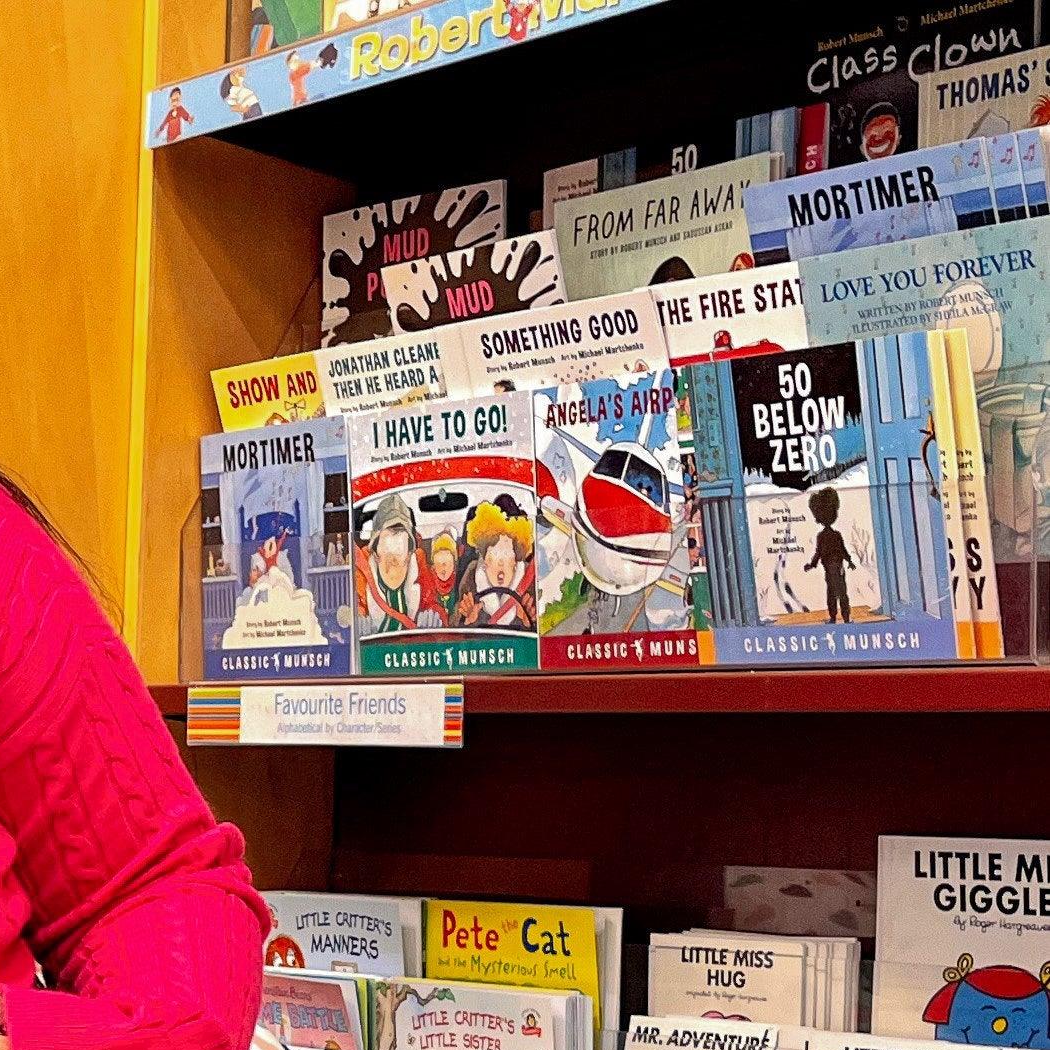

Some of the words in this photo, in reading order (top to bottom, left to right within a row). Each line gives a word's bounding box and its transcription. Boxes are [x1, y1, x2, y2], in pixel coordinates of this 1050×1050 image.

[920, 9, 957, 26] Michael
[349, 0, 514, 80] Robert
[817, 37, 846, 52] Robert
[807, 44, 897, 94] Class
[908, 27, 1022, 83] Clown
[936, 60, 1037, 110] THOMAS'
[671, 144, 698, 175] 50
[787, 166, 940, 228] MORTIMER
[574, 207, 633, 246] FROM
[644, 195, 680, 229] FAR
[383, 227, 429, 263] MUD
[620, 241, 643, 253] ROBERT
[645, 235, 668, 248] MUNSCH
[821, 274, 876, 304] LOVE
[879, 266, 926, 292] YOU
[933, 249, 1036, 285] FOREVER
[446, 280, 495, 318] MUD
[656, 298, 693, 326] THE
[699, 288, 745, 320] FIRE
[857, 302, 904, 320] WRITTEN
[906, 301, 918, 312] BY
[919, 294, 957, 310] ROBERT
[480, 317, 583, 360] SOMETHING
[589, 309, 640, 341] GOOD
[508, 359, 530, 371] Robert
[531, 356, 556, 367] Munsch
[578, 348, 604, 360] Michael
[605, 343, 644, 355] Martchenko
[328, 353, 390, 378] JONATHAN
[227, 375, 280, 409] SHOW
[286, 370, 317, 398] AND
[333, 380, 363, 399] THEN
[366, 377, 381, 394] HE
[384, 368, 425, 392] HEARD
[430, 365, 438, 385] A
[778, 362, 812, 399] 50
[359, 402, 379, 412] Robert
[546, 394, 623, 428] ANGELA'S
[631, 387, 674, 417] AIRP
[752, 396, 845, 439] BELOW
[373, 422, 379, 448] I
[386, 415, 434, 447] HAVE
[441, 410, 466, 439] TO
[474, 404, 508, 436] GO!
[222, 432, 316, 473] MORTIMER
[391, 452, 410, 461] Robert
[411, 449, 433, 458] Munsch
[453, 444, 476, 453] Michael
[769, 435, 837, 473] ZERO
[566, 641, 628, 660] CLASSIC
[650, 640, 698, 657] MUNS
[743, 636, 820, 653] CLASSIC
[844, 633, 921, 650] MUNSCH
[222, 656, 270, 670] CLASSIC
[284, 653, 330, 668] MUNSCH
[384, 650, 440, 667] CLASSIC
[458, 648, 515, 664] MUNSCH
[274, 693, 343, 716] Favourite
[349, 693, 406, 715] Friends
[277, 722, 323, 734] Alphabetical
[325, 723, 334, 734] by
[914, 851, 1002, 881] LITTLE
[934, 883, 1050, 916] GIGGLE
[296, 911, 331, 930] LITTLE
[335, 911, 393, 937] CRITTER'S
[442, 909, 499, 951] Pete
[502, 919, 519, 933] the
[521, 917, 571, 957] Cat
[954, 915, 966, 931] By
[970, 915, 997, 933] Roger
[311, 934, 379, 959] MANNERS
[681, 946, 729, 966] LITTLE
[733, 949, 774, 969] MISS
[453, 957, 466, 967] the
[470, 955, 538, 978] Mysterious
[543, 960, 577, 981] Smell
[707, 969, 746, 988] HUG
[287, 1002, 349, 1033] BATTLE
[412, 1010, 449, 1030] LITTLE
[455, 1010, 515, 1035] CRITTER'S
[420, 1033, 461, 1050] LITTLE
[632, 1025, 663, 1045] MR.
